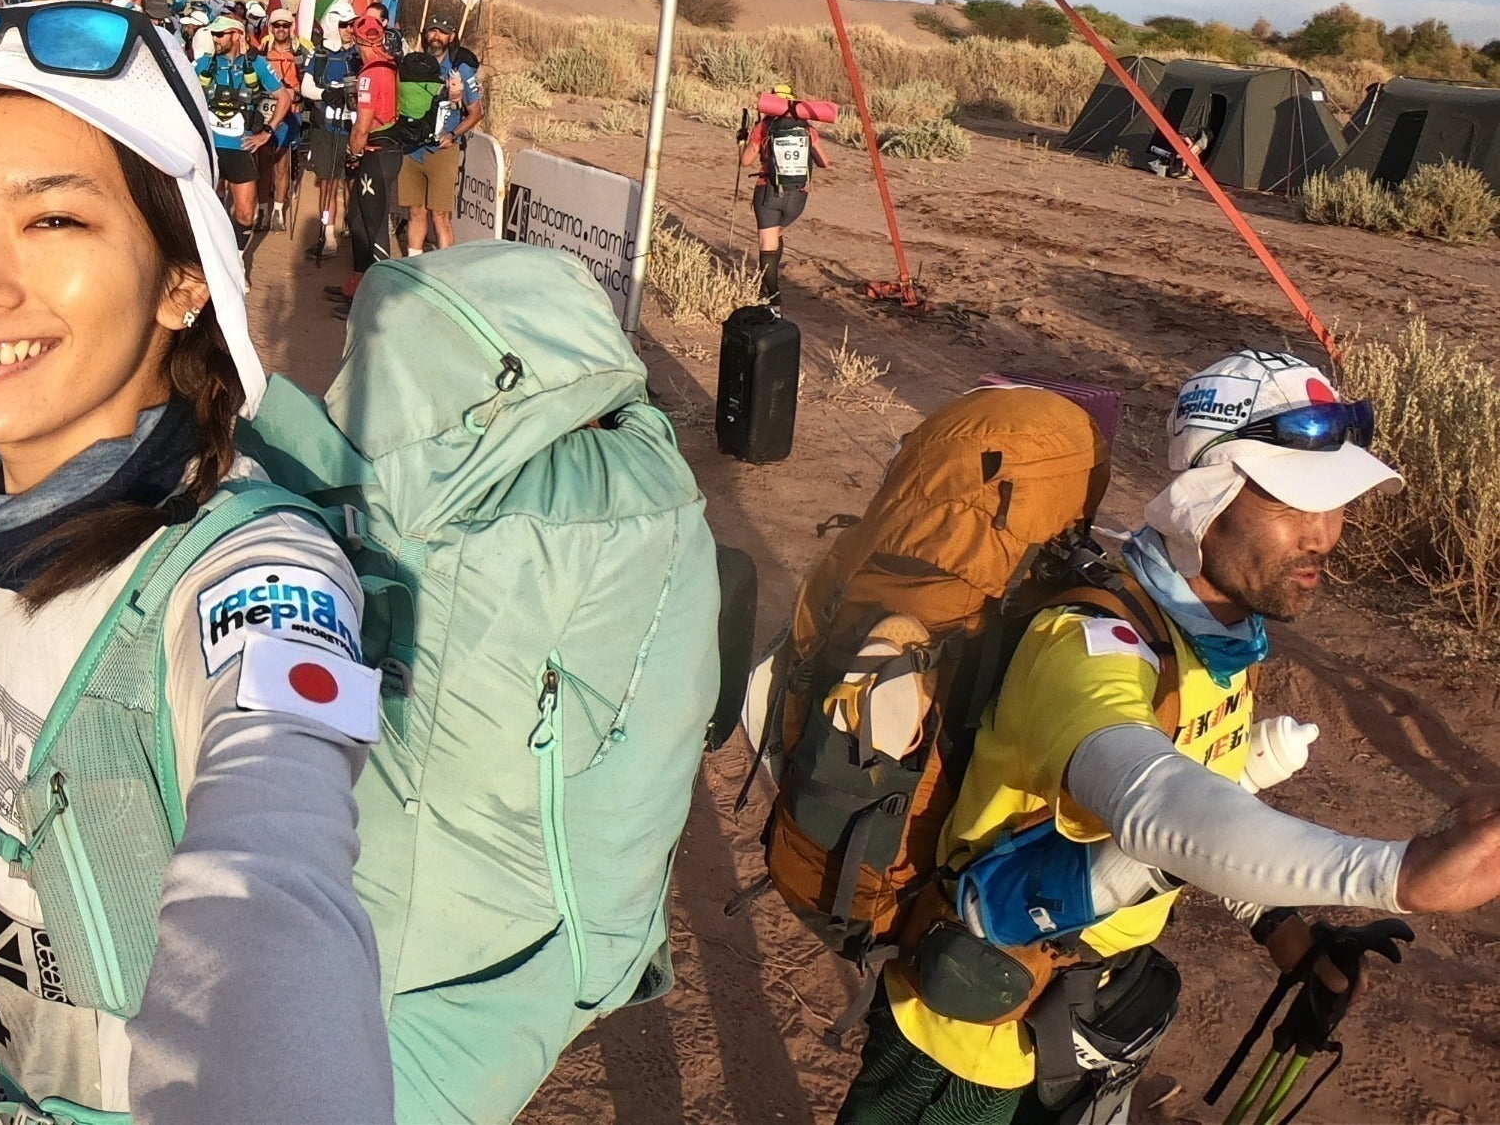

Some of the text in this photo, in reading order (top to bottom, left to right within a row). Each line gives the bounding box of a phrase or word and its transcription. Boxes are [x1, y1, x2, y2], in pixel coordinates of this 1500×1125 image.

[783, 150, 801, 161] 69
[464, 175, 495, 203] namib
[457, 196, 495, 230] arctica
[209, 574, 336, 623] racing
